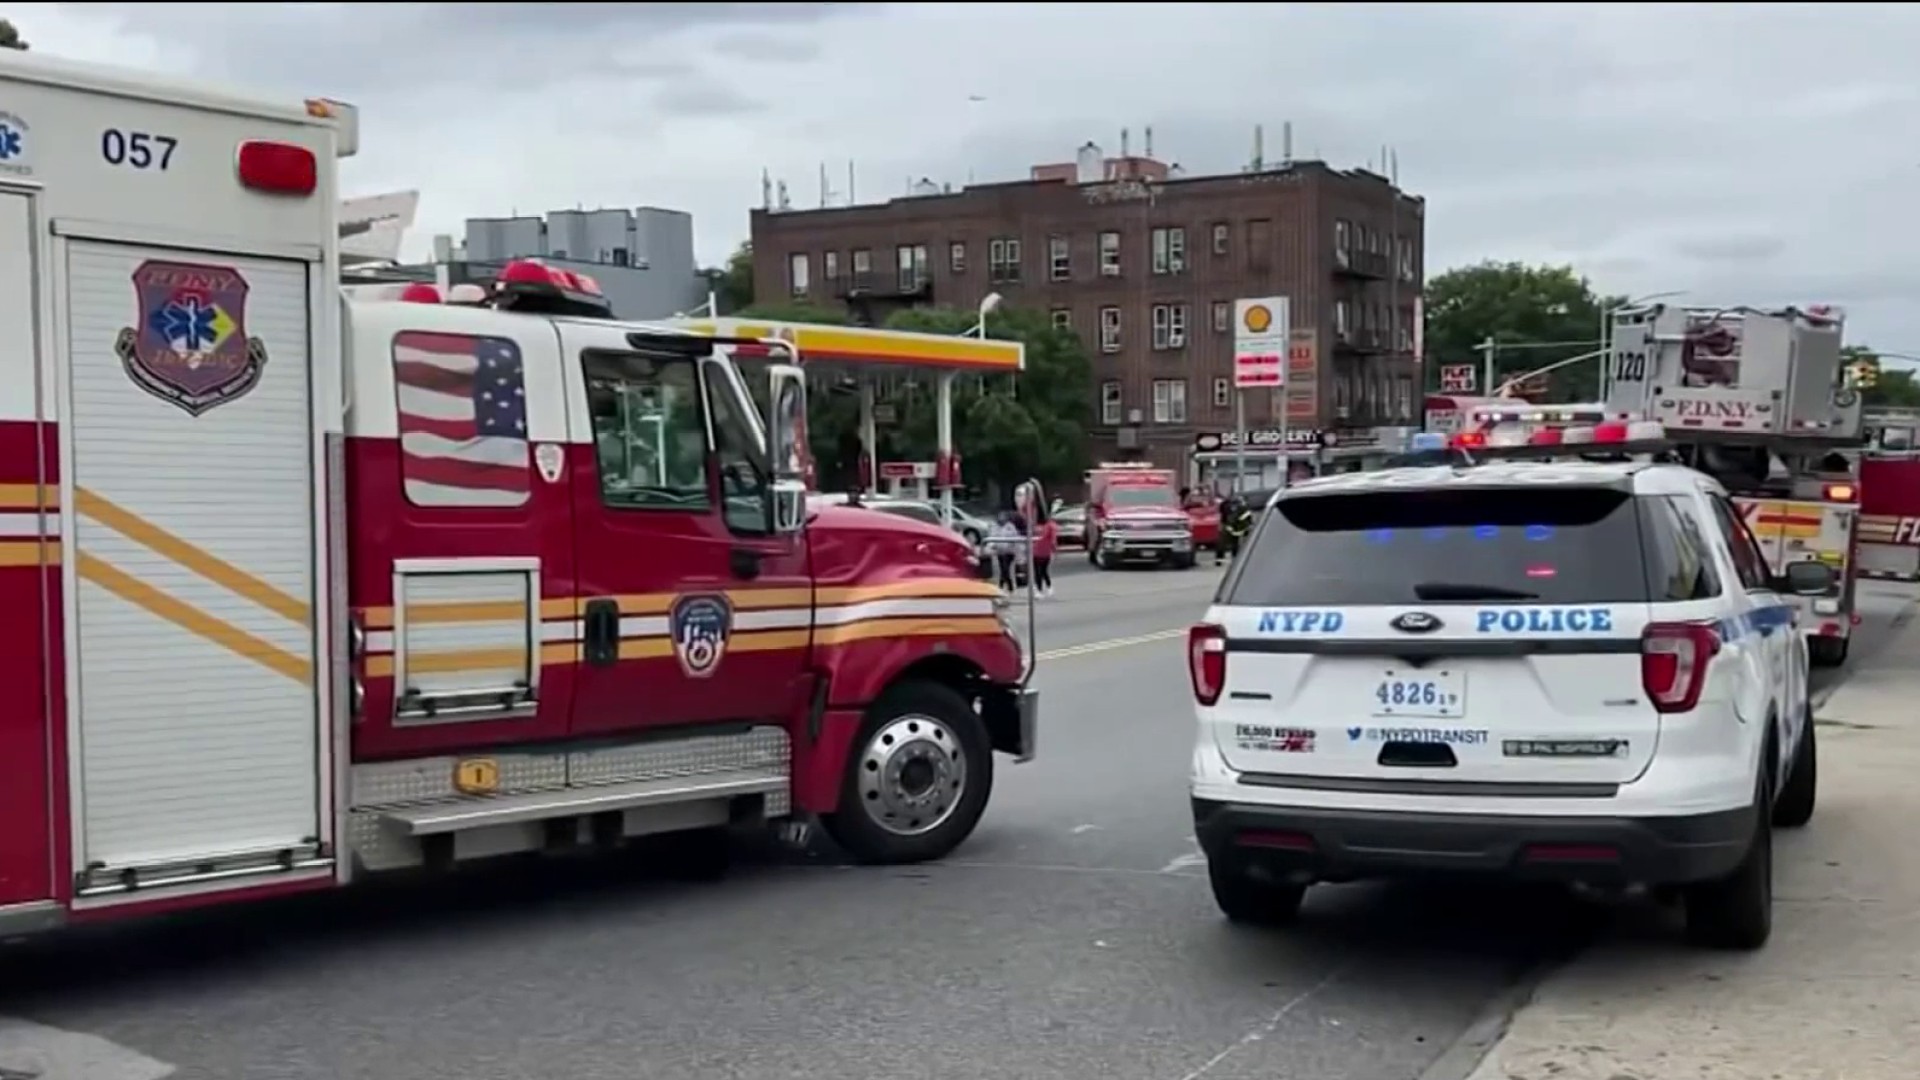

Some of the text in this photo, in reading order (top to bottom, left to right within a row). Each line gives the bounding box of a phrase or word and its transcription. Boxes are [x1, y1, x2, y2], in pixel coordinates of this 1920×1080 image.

[102, 128, 178, 170] 057
[1616, 352, 1645, 382] 120
[1677, 400, 1753, 418] F.D.N.Y.
[1221, 430, 1314, 444] DEI GROERY
[1258, 611, 1344, 633] NYPD
[1476, 609, 1612, 632] POLICE
[1376, 682, 1436, 705] 4826
